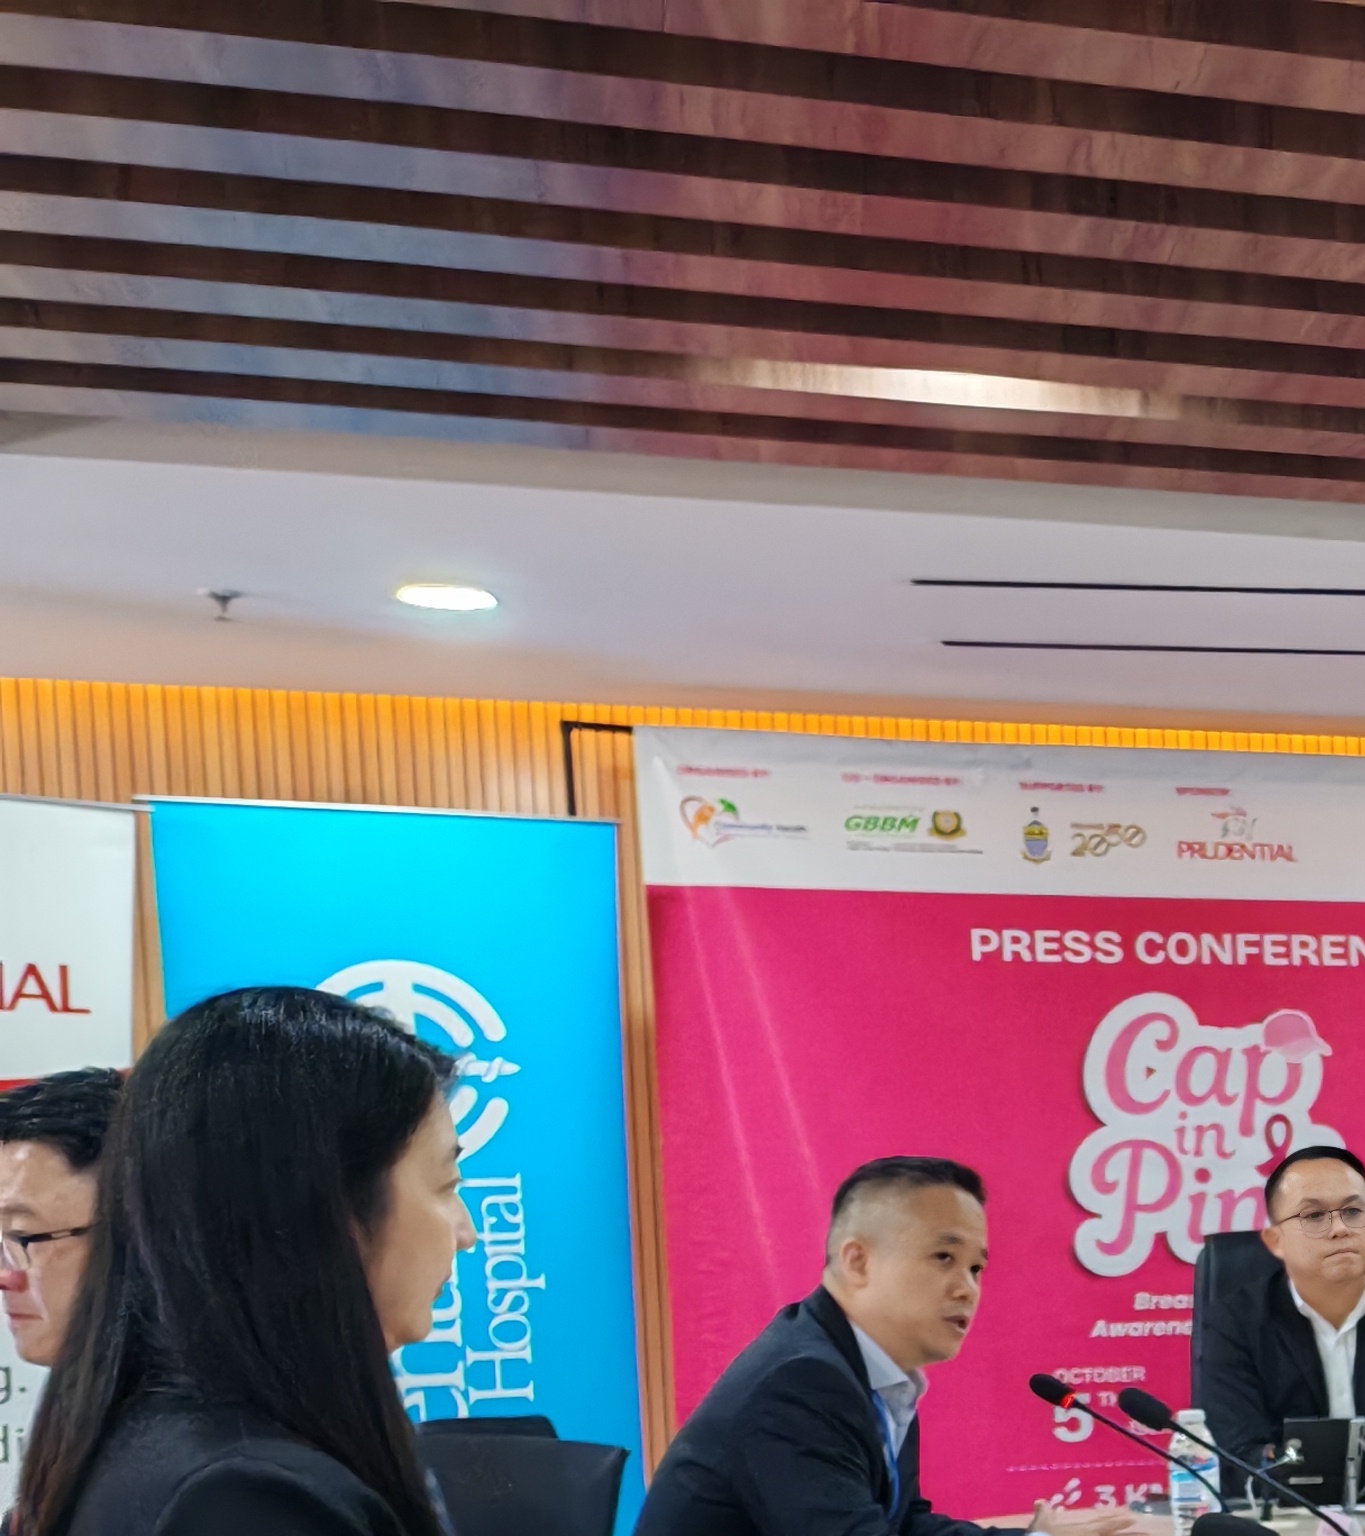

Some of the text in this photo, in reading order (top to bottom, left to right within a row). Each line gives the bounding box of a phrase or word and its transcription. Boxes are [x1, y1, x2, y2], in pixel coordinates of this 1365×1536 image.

[844, 814, 921, 832] GBBM
[1176, 840, 1298, 863] PRUDENTIAL
[970, 928, 1124, 964] PRESS
[1104, 1012, 1303, 1137] Cap
[1174, 1111, 1235, 1159] in
[1090, 1139, 1268, 1256] Pin
[461, 1172, 546, 1402] Hospital
[1133, 1291, 1194, 1310] Brea
[1053, 1365, 1147, 1384] OCTOBER
